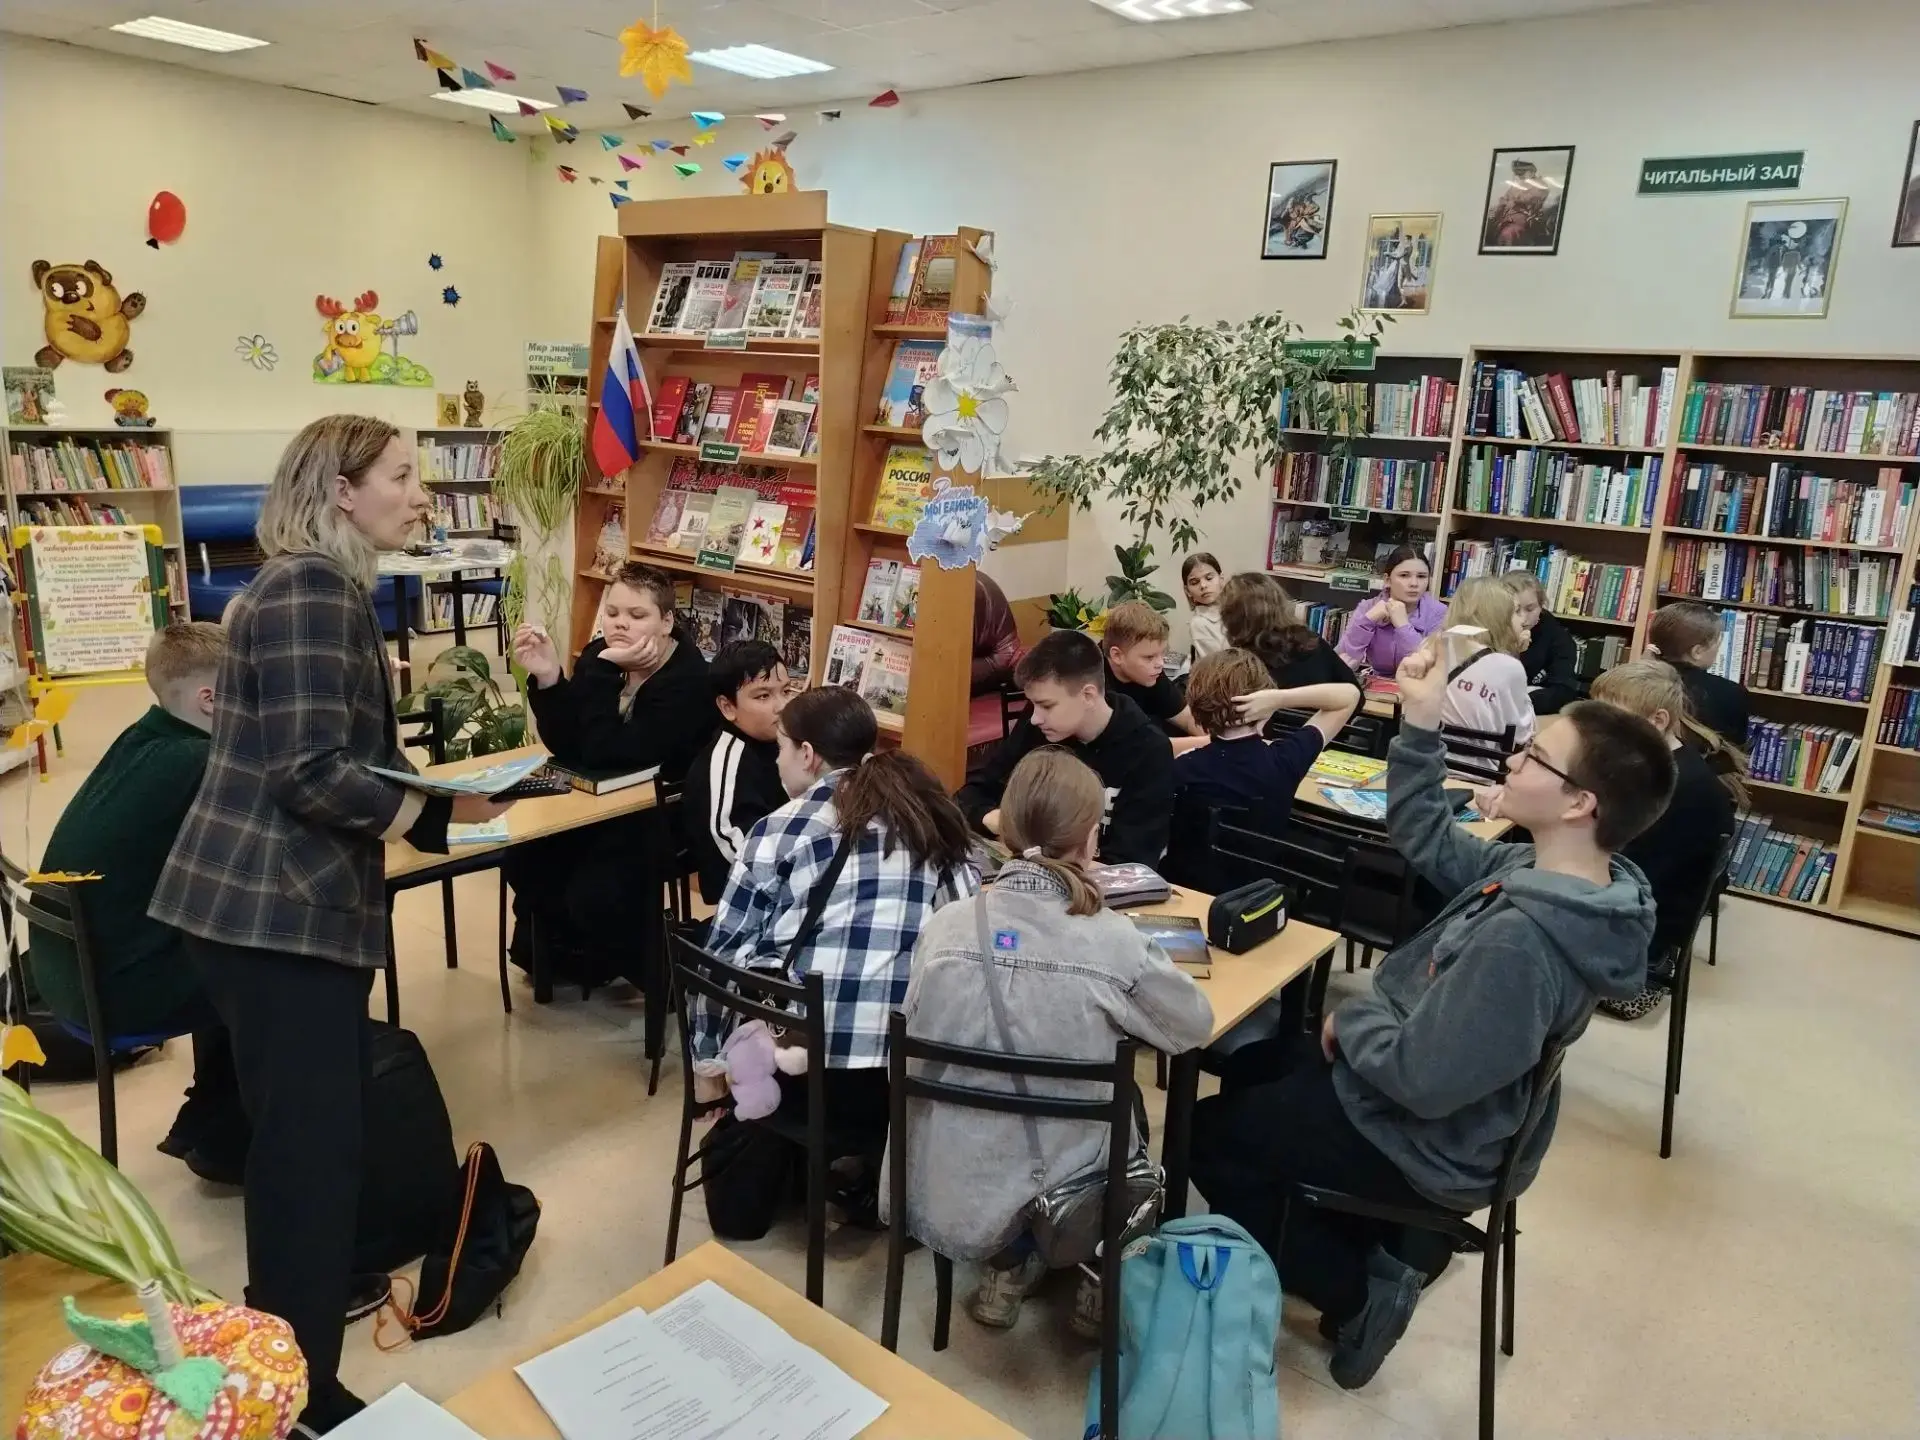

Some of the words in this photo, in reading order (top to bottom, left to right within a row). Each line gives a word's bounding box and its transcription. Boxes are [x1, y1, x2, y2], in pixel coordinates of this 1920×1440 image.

[1644, 164, 1756, 185] ЧИТАЛЬНЫЙ
[1759, 164, 1799, 181] ЗАЛ
[528, 343, 547, 353] Мир
[889, 469, 931, 484] РОССИЯ
[924, 502, 942, 516] МЫ
[943, 498, 979, 514] ЕДИНЫ!
[1610, 490, 1624, 522] Техника
[1865, 503, 1878, 541] Экономика
[1344, 560, 1373, 573] ТОМСК
[1708, 563, 1720, 595] Право
[836, 633, 872, 647] ДРЕВНЯЯ
